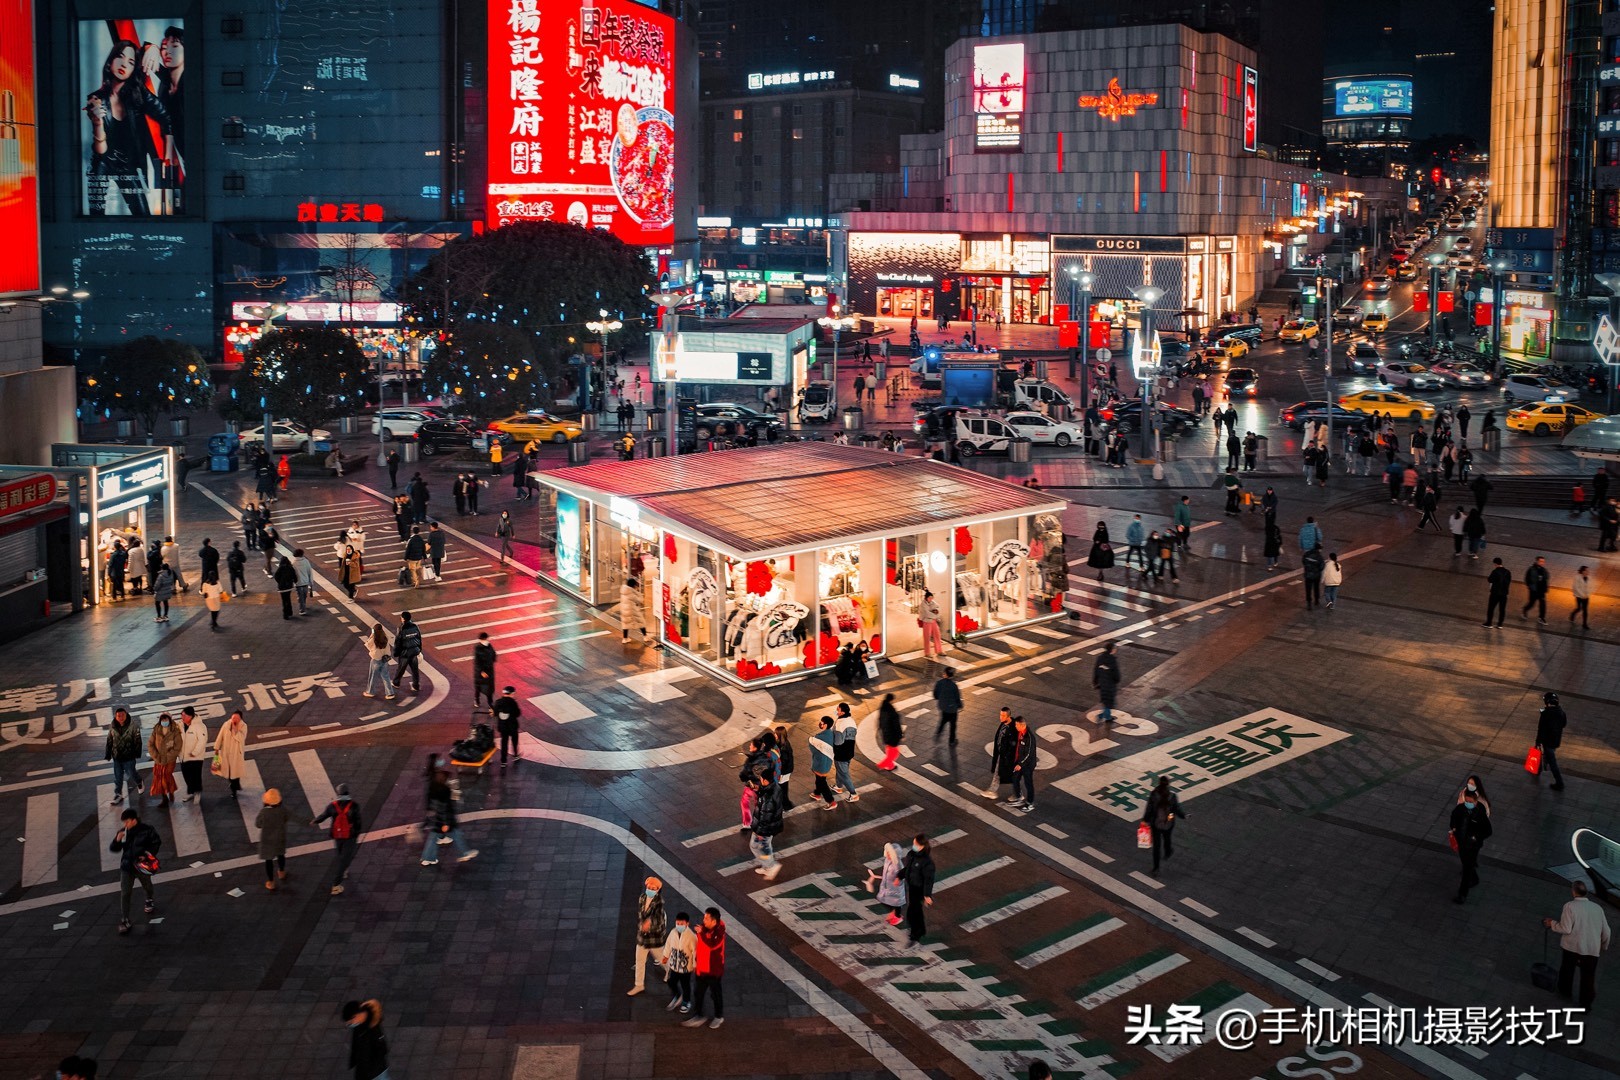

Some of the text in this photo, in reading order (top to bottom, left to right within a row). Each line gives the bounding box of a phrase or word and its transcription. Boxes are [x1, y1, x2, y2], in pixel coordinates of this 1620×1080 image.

[507, 0, 544, 136] 楊記隆府
[1096, 240, 1140, 249] GUCCI
